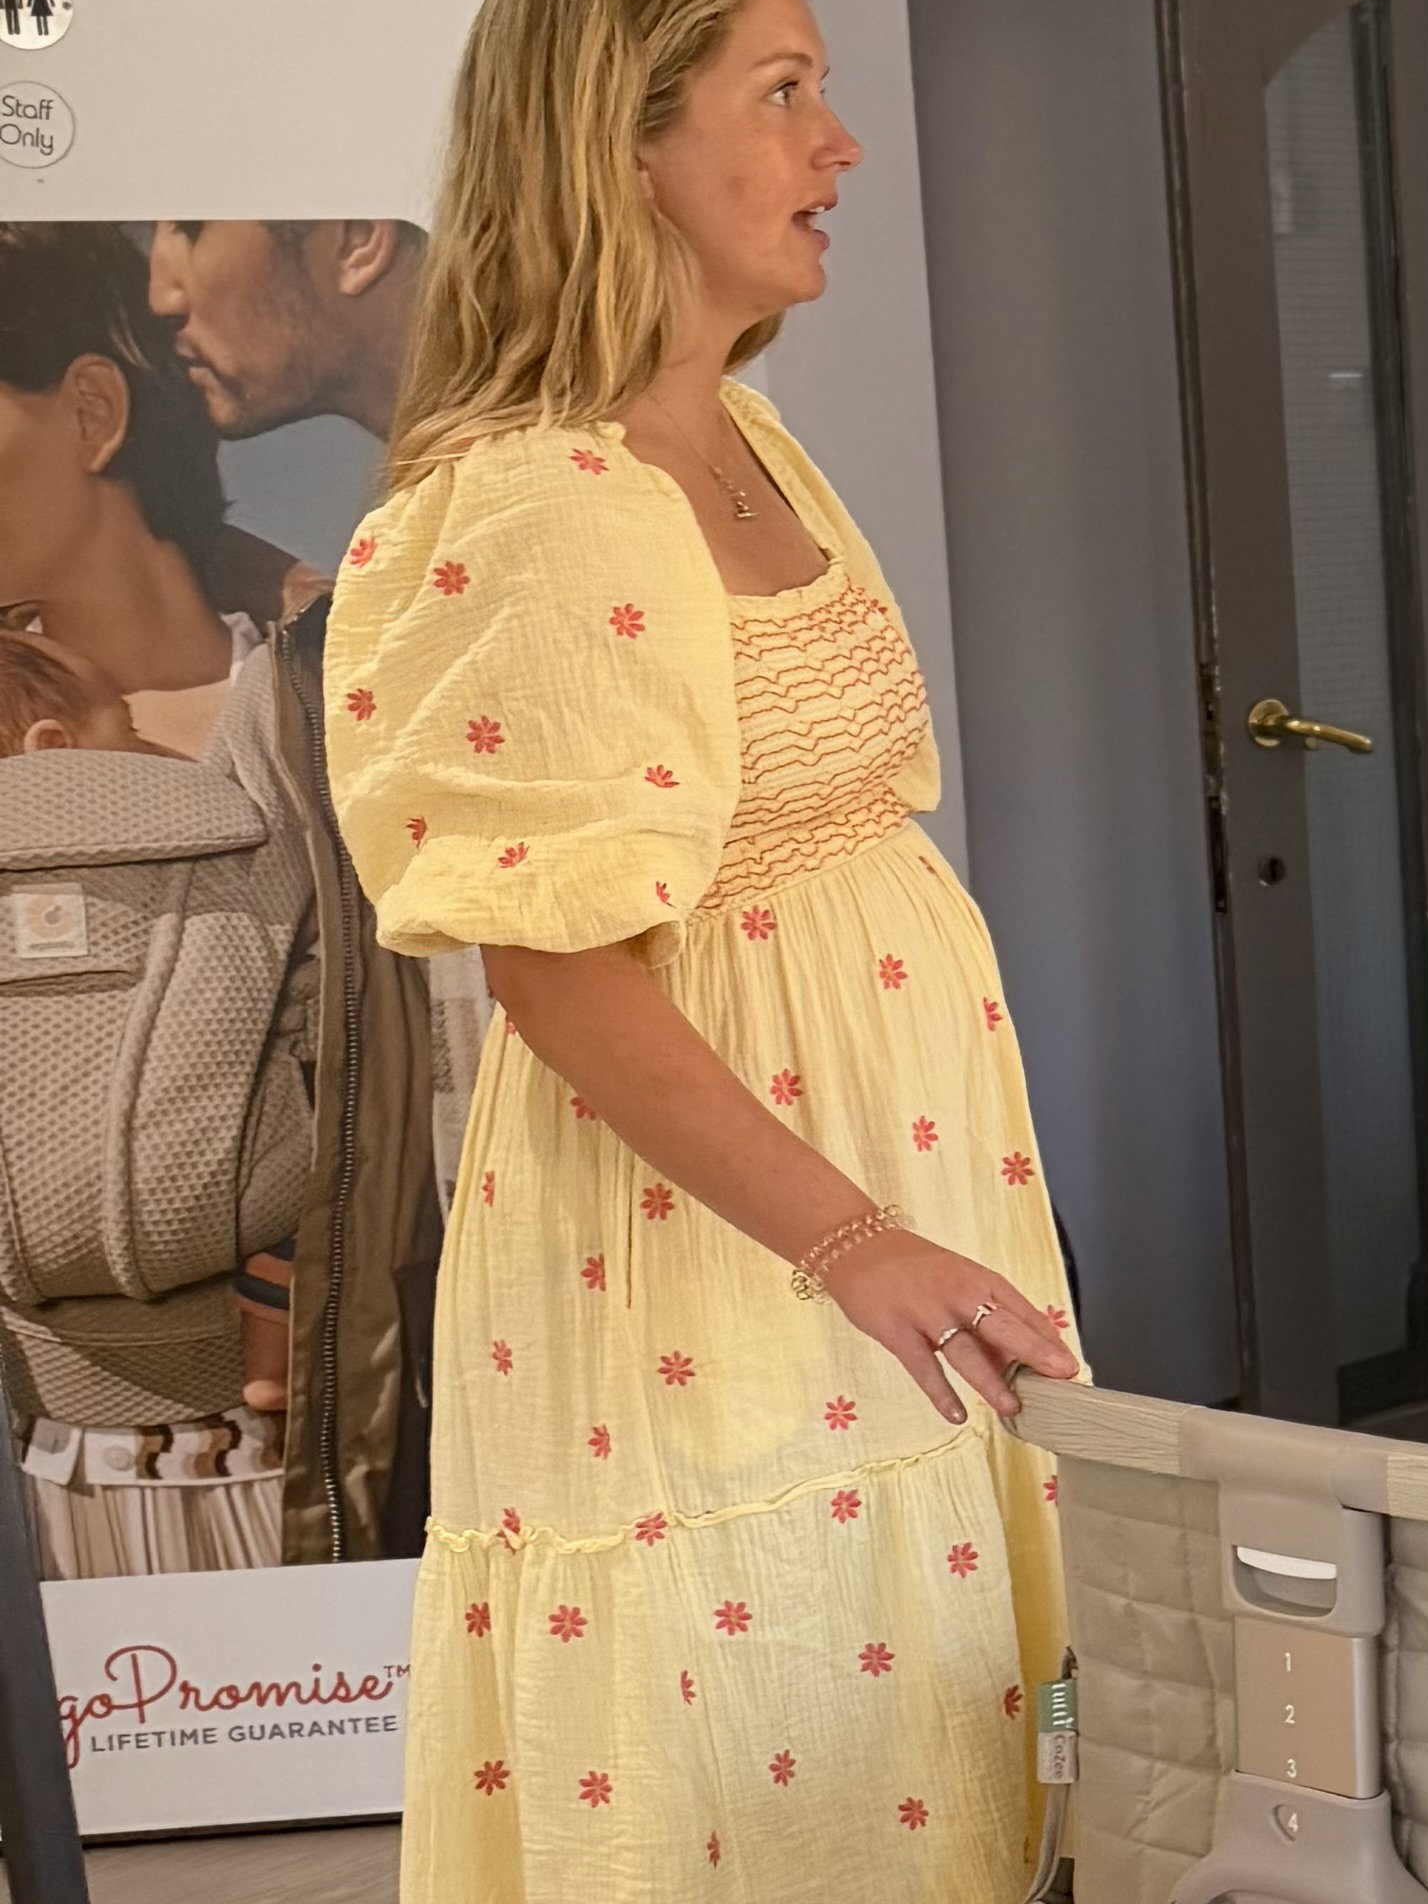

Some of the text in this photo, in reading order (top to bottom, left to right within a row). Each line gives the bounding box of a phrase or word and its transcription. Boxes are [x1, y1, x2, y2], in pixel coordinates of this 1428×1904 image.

[2, 94, 54, 120] Staff
[0, 122, 54, 156] Only
[1284, 1652, 1292, 1672] 1
[1284, 1704, 1296, 1724] 2
[91, 1715, 398, 1752] LIFETIME GUARANTEE
[1286, 1758, 1297, 1778] 3
[1287, 1812, 1298, 1832] 4
